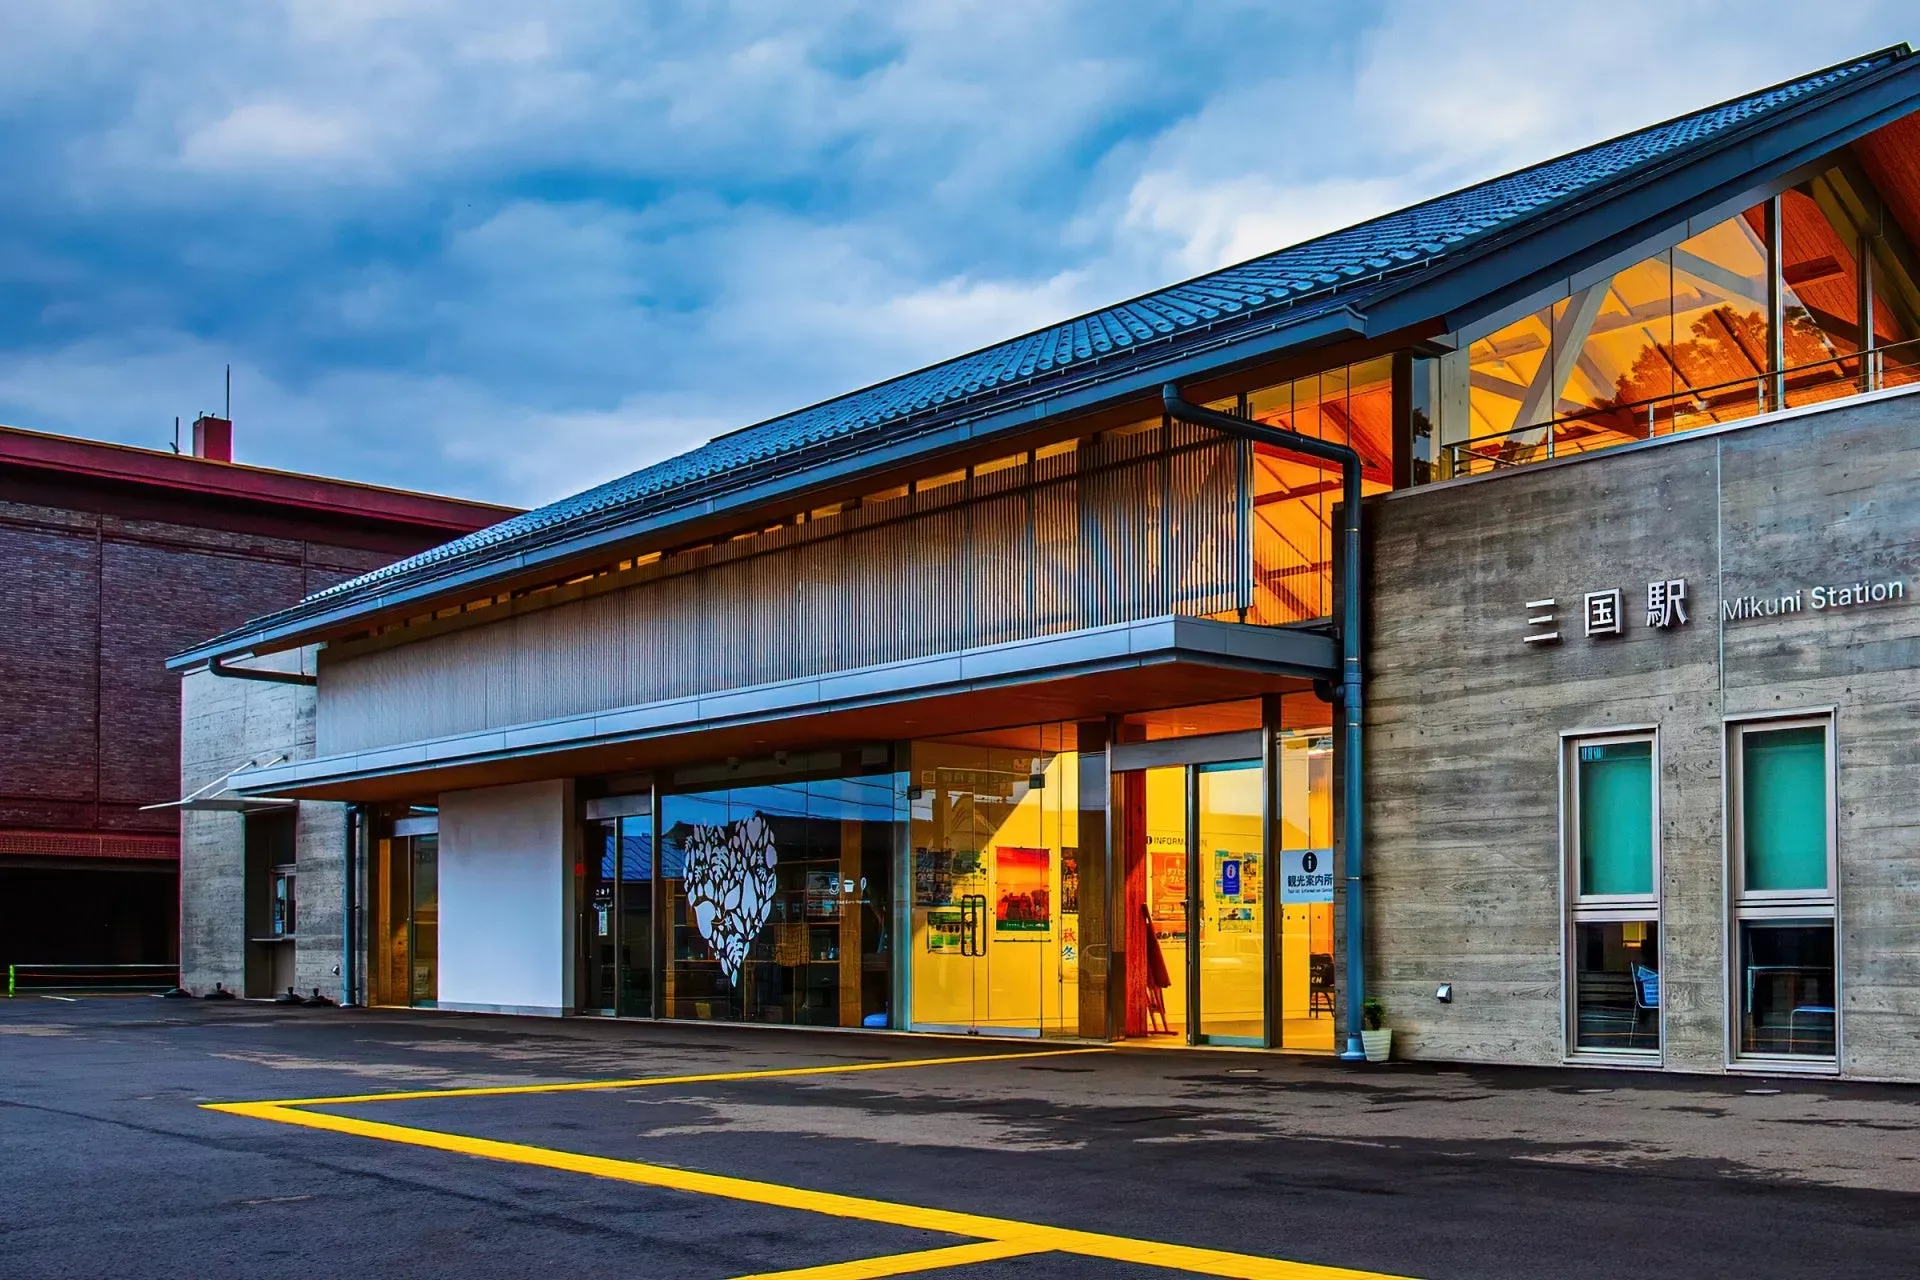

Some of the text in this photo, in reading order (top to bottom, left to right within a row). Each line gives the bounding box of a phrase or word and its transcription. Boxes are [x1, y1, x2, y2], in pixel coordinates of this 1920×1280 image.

[1523, 578, 1689, 642] 三国駅
[1722, 579, 1904, 622] Mikuni Station
[1287, 873, 1333, 887] 観光案内所
